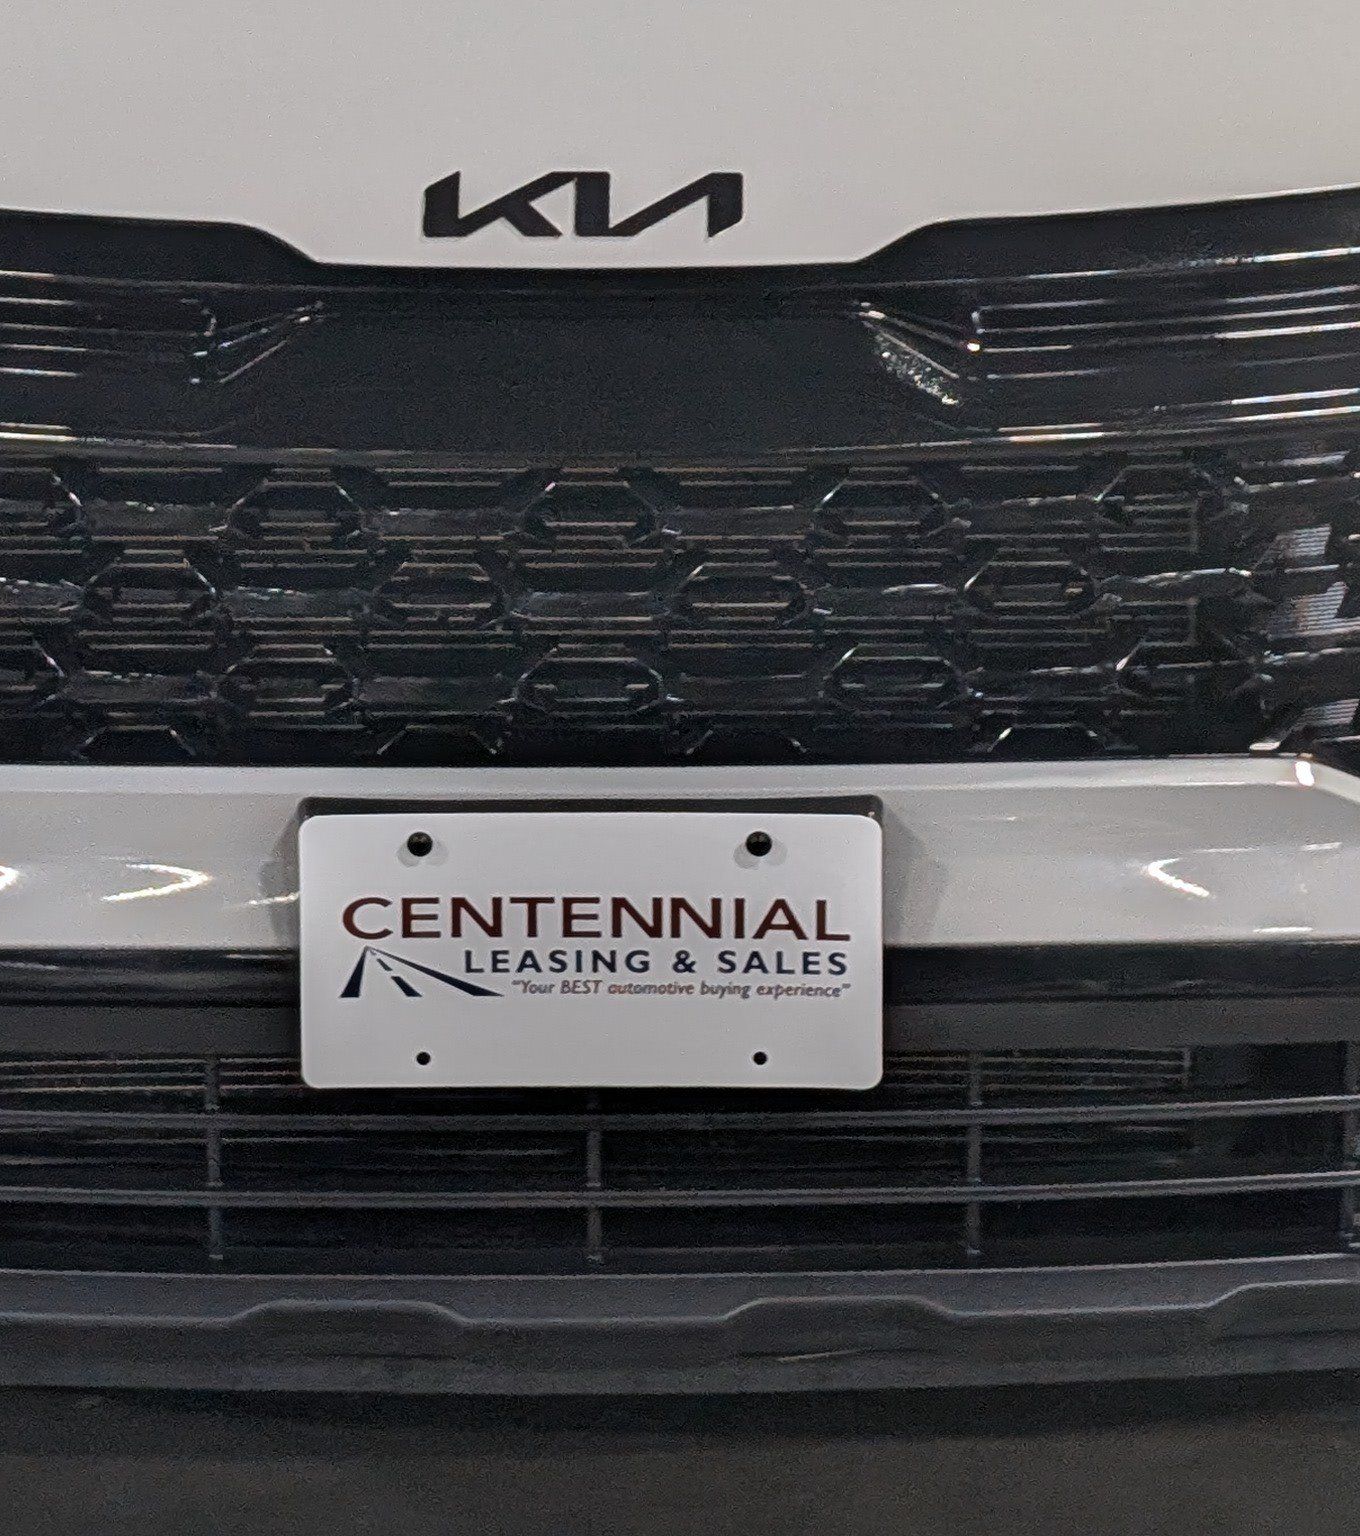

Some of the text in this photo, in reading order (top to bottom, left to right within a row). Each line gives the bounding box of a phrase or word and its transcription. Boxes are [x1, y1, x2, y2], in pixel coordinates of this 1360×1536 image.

[422, 170, 743, 238] KIA
[342, 897, 851, 942] CENTENNIAL
[464, 949, 848, 975] LEASING & SALES
[559, 979, 604, 994] BEST
[607, 981, 695, 996] automotive
[700, 980, 752, 999] buying
